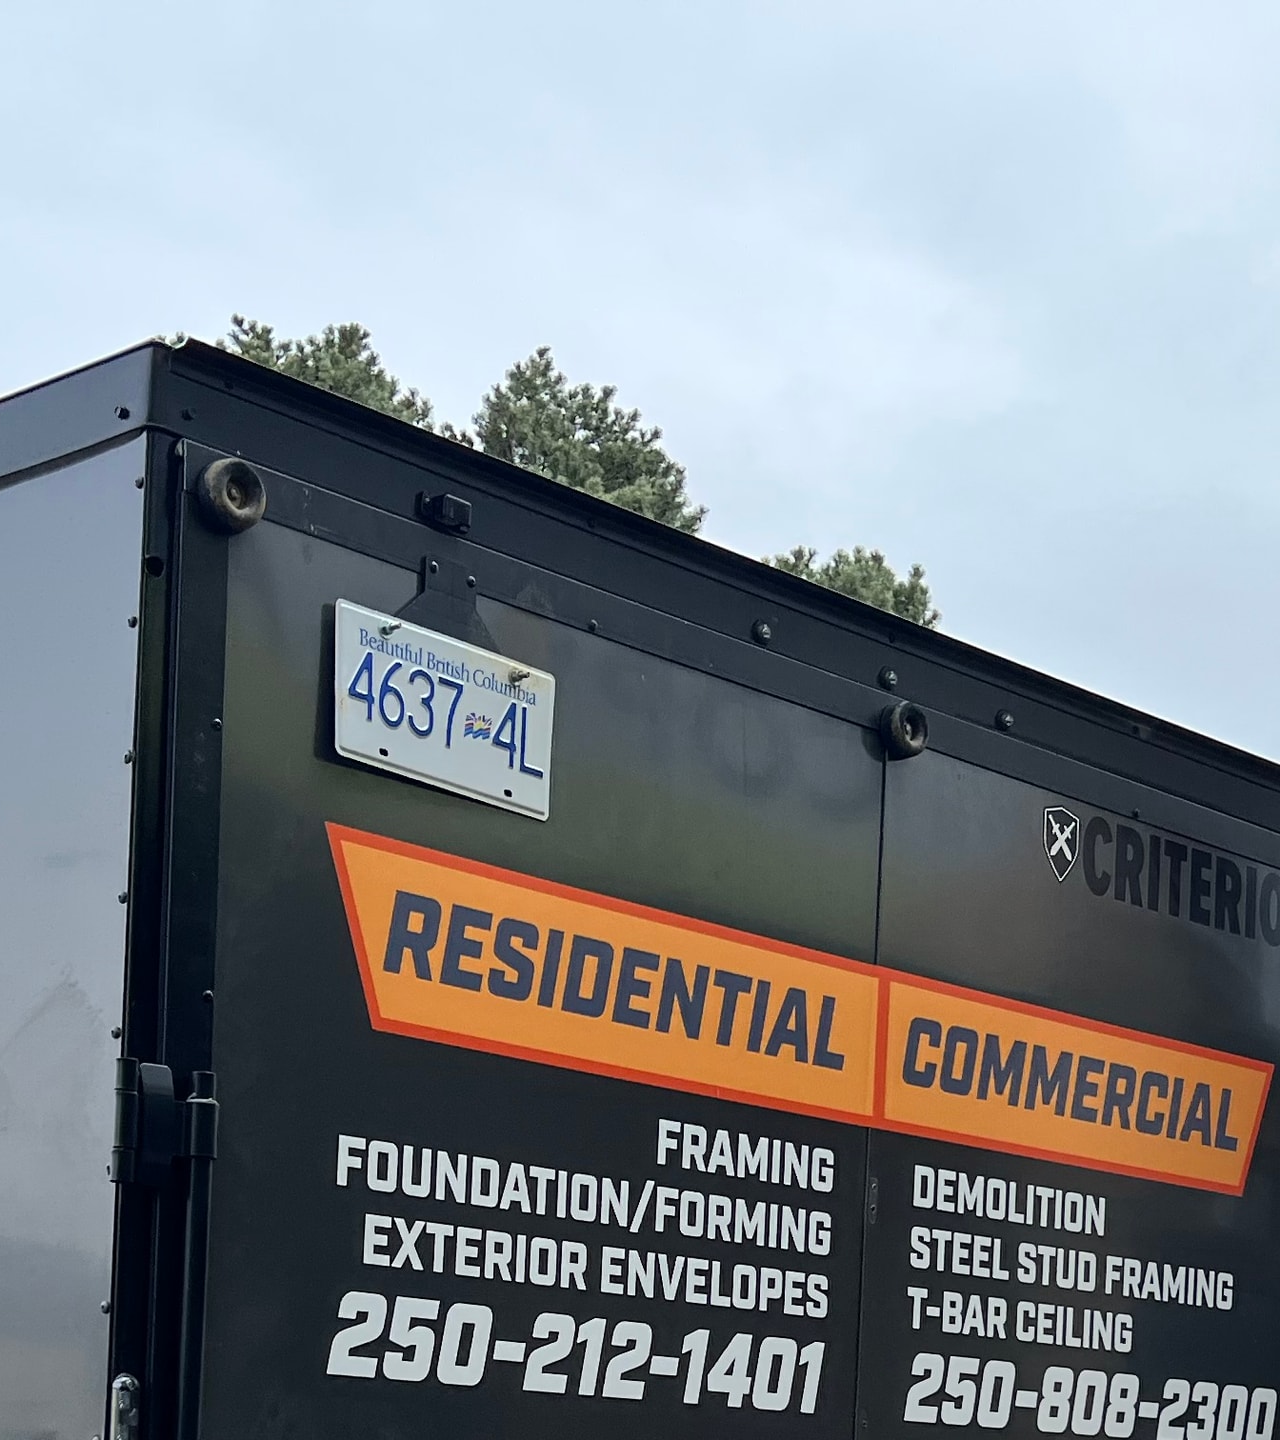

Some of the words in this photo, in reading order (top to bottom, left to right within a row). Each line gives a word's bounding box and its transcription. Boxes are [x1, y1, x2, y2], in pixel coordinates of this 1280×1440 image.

[348, 651, 464, 750] 4637
[491, 701, 544, 779] 4L
[359, 628, 424, 667] Beautiful
[426, 651, 471, 684] British
[472, 669, 537, 707] Columbia
[383, 890, 846, 1072] RESIDENTIAL
[901, 1017, 1238, 1151] COMMERCIAL
[336, 1133, 832, 1257] FOUNDATION/FORMING
[656, 1119, 835, 1194] FRAMING
[912, 1164, 1107, 1236] DEMOLITION
[362, 1213, 588, 1292] EXTERIOR
[600, 1240, 830, 1319] ENVELOPES
[909, 1225, 1006, 1283] STEEL
[1016, 1243, 1098, 1293] STUD
[1105, 1257, 1234, 1311] FRAMING
[325, 1291, 827, 1414] 250-212-1401
[907, 1286, 1007, 1341] T-BAR
[1015, 1303, 1134, 1354] CEILING
